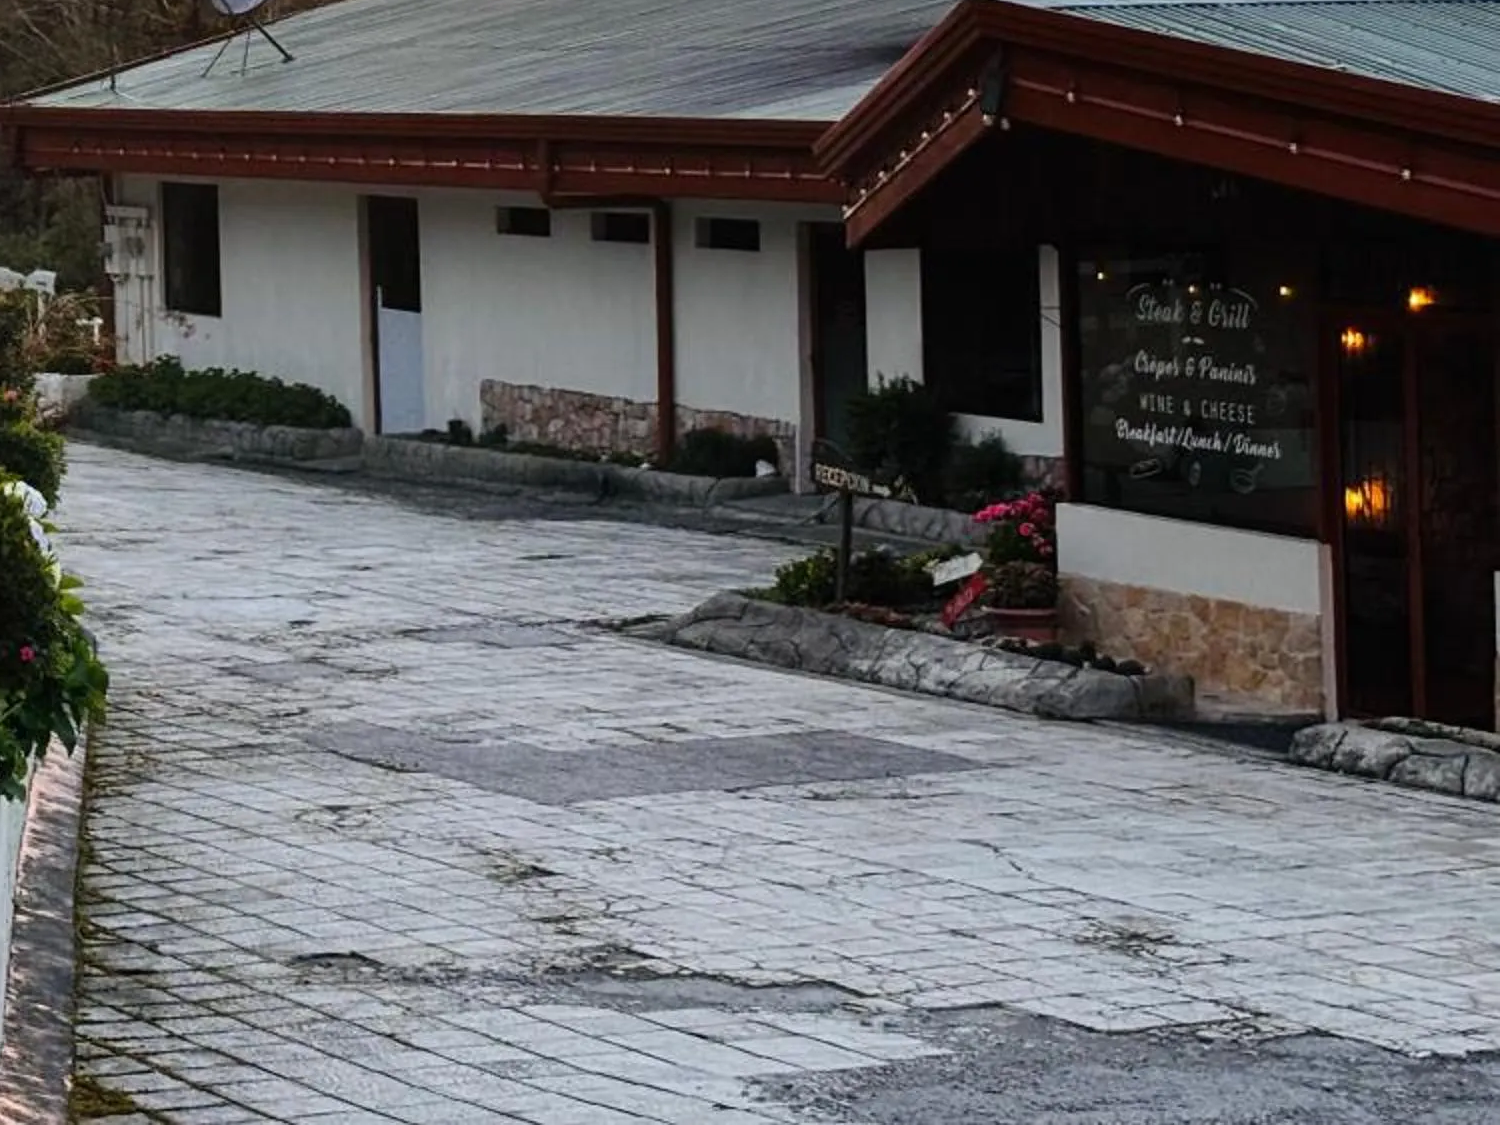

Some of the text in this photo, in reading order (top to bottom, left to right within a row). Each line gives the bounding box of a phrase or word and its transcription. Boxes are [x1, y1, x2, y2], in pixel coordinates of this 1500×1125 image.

[1135, 294, 1185, 324] Steak
[1208, 298, 1252, 330] Grill
[1139, 394, 1257, 425] WINE & CHEESE
